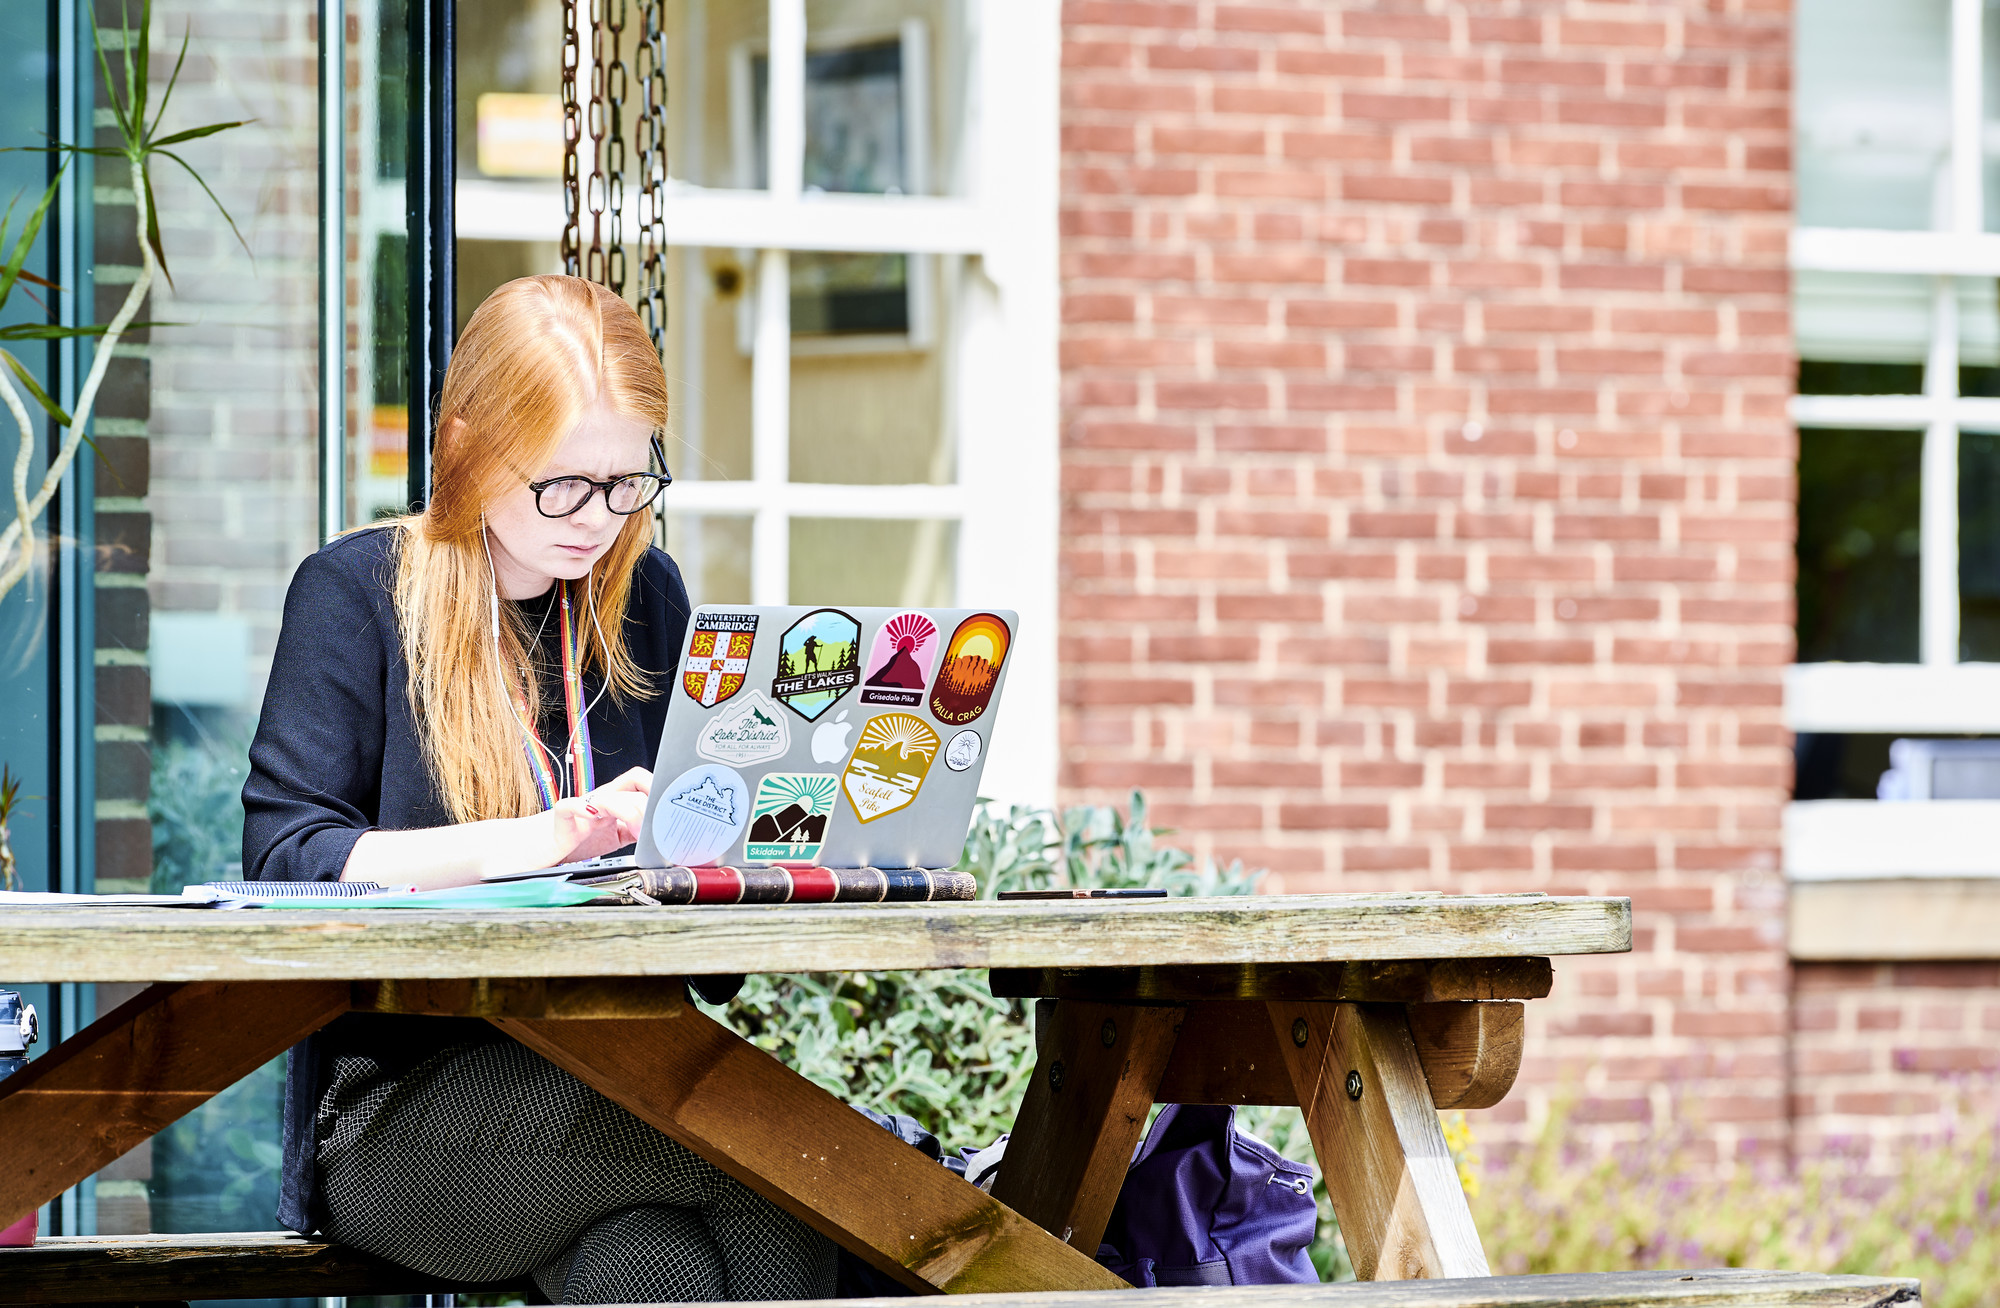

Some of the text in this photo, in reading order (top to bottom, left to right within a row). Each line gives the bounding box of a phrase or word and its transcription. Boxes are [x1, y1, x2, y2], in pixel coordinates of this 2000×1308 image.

[698, 614, 747, 622] UNIVERSITY
[696, 621, 755, 631] CAMBRIDGE
[775, 681, 804, 693] THE
[807, 674, 854, 689] LAKES
[869, 693, 915, 703] Grisedale Pike
[932, 697, 982, 721] WALLA CRAG
[740, 719, 758, 730] The
[710, 728, 779, 743] Lake District
[859, 783, 893, 801] Scafell
[688, 796, 702, 805] LAKE
[702, 801, 727, 813] DISTRICT
[705, 795, 716, 803] THE
[859, 799, 881, 812] Pike
[750, 848, 785, 856] Skiddaw
